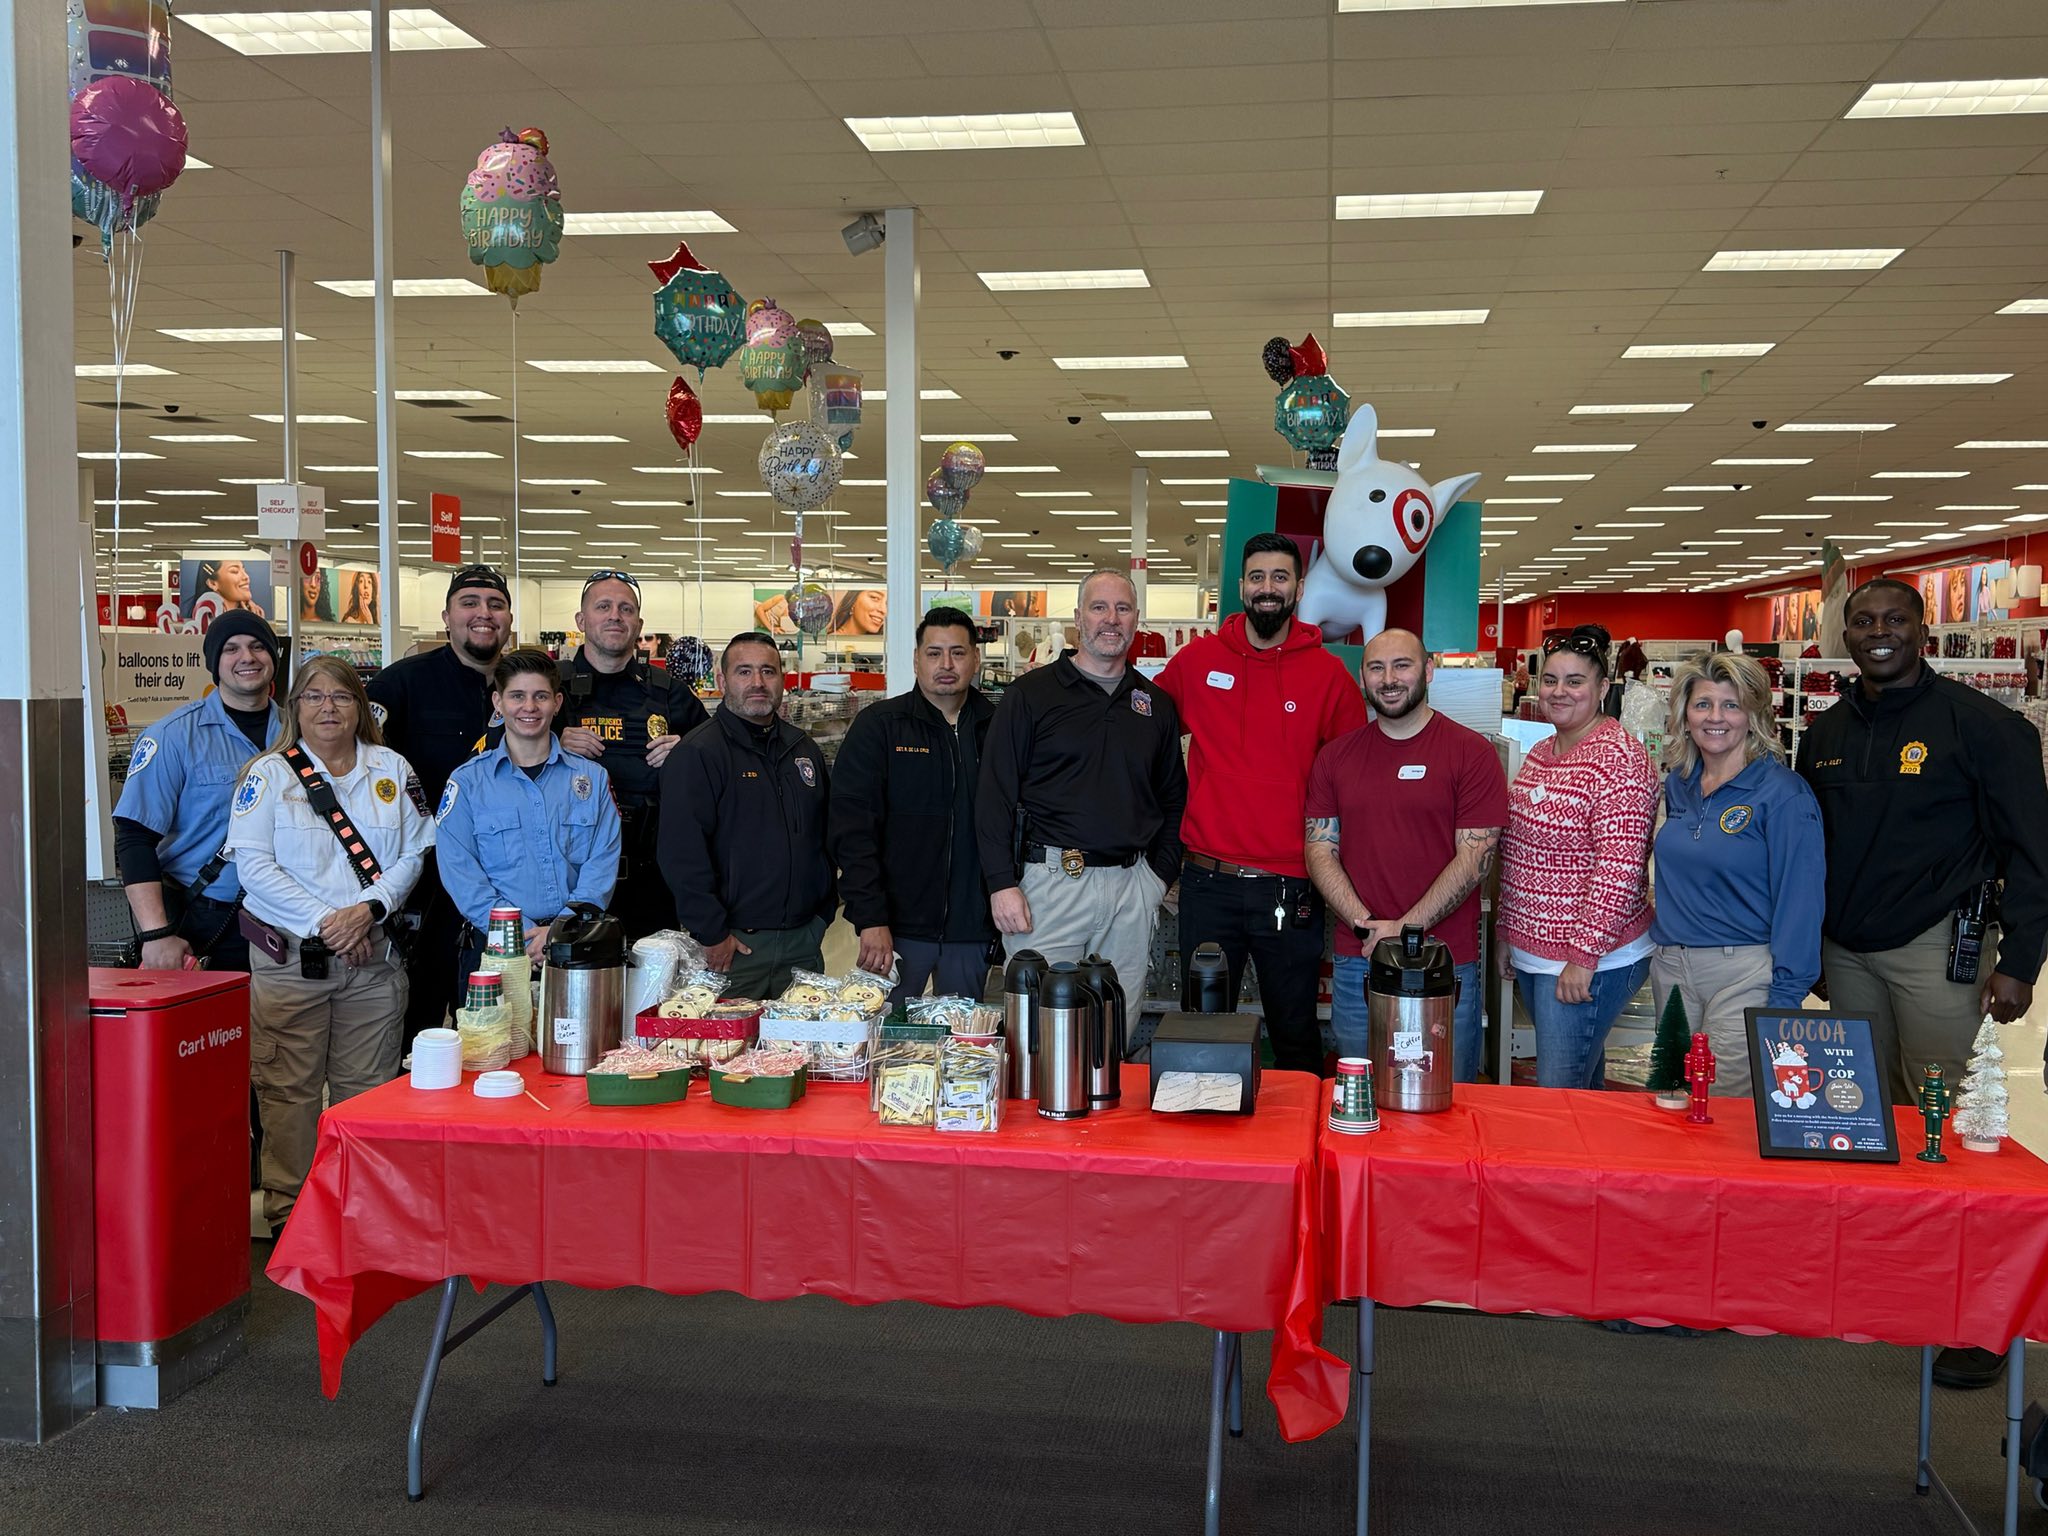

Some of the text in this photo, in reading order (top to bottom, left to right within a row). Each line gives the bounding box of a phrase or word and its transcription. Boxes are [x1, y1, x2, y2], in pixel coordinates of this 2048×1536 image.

[476, 205, 533, 227] HAPPY
[469, 229, 544, 249] BIRTHDAY
[749, 351, 786, 366] HAPPY
[744, 364, 793, 380] BIRTHDAY
[780, 446, 817, 458] HAPPY
[440, 511, 453, 522] Self
[433, 523, 460, 536] checkout
[305, 551, 311, 568] 1
[118, 652, 200, 668] balloons to lift
[135, 672, 185, 690] their day
[369, 703, 386, 717] MT
[246, 774, 263, 786] MT
[1559, 769, 1599, 794] CHEERS
[1535, 851, 1591, 868] CHEERS
[1779, 1018, 1847, 1045] COCOA
[178, 1026, 242, 1057] Cart Wipes
[1400, 1035, 1421, 1049] Coffee
[1823, 1048, 1854, 1057] WITH
[1836, 1058, 1844, 1066] A
[1828, 1069, 1855, 1079] COP
